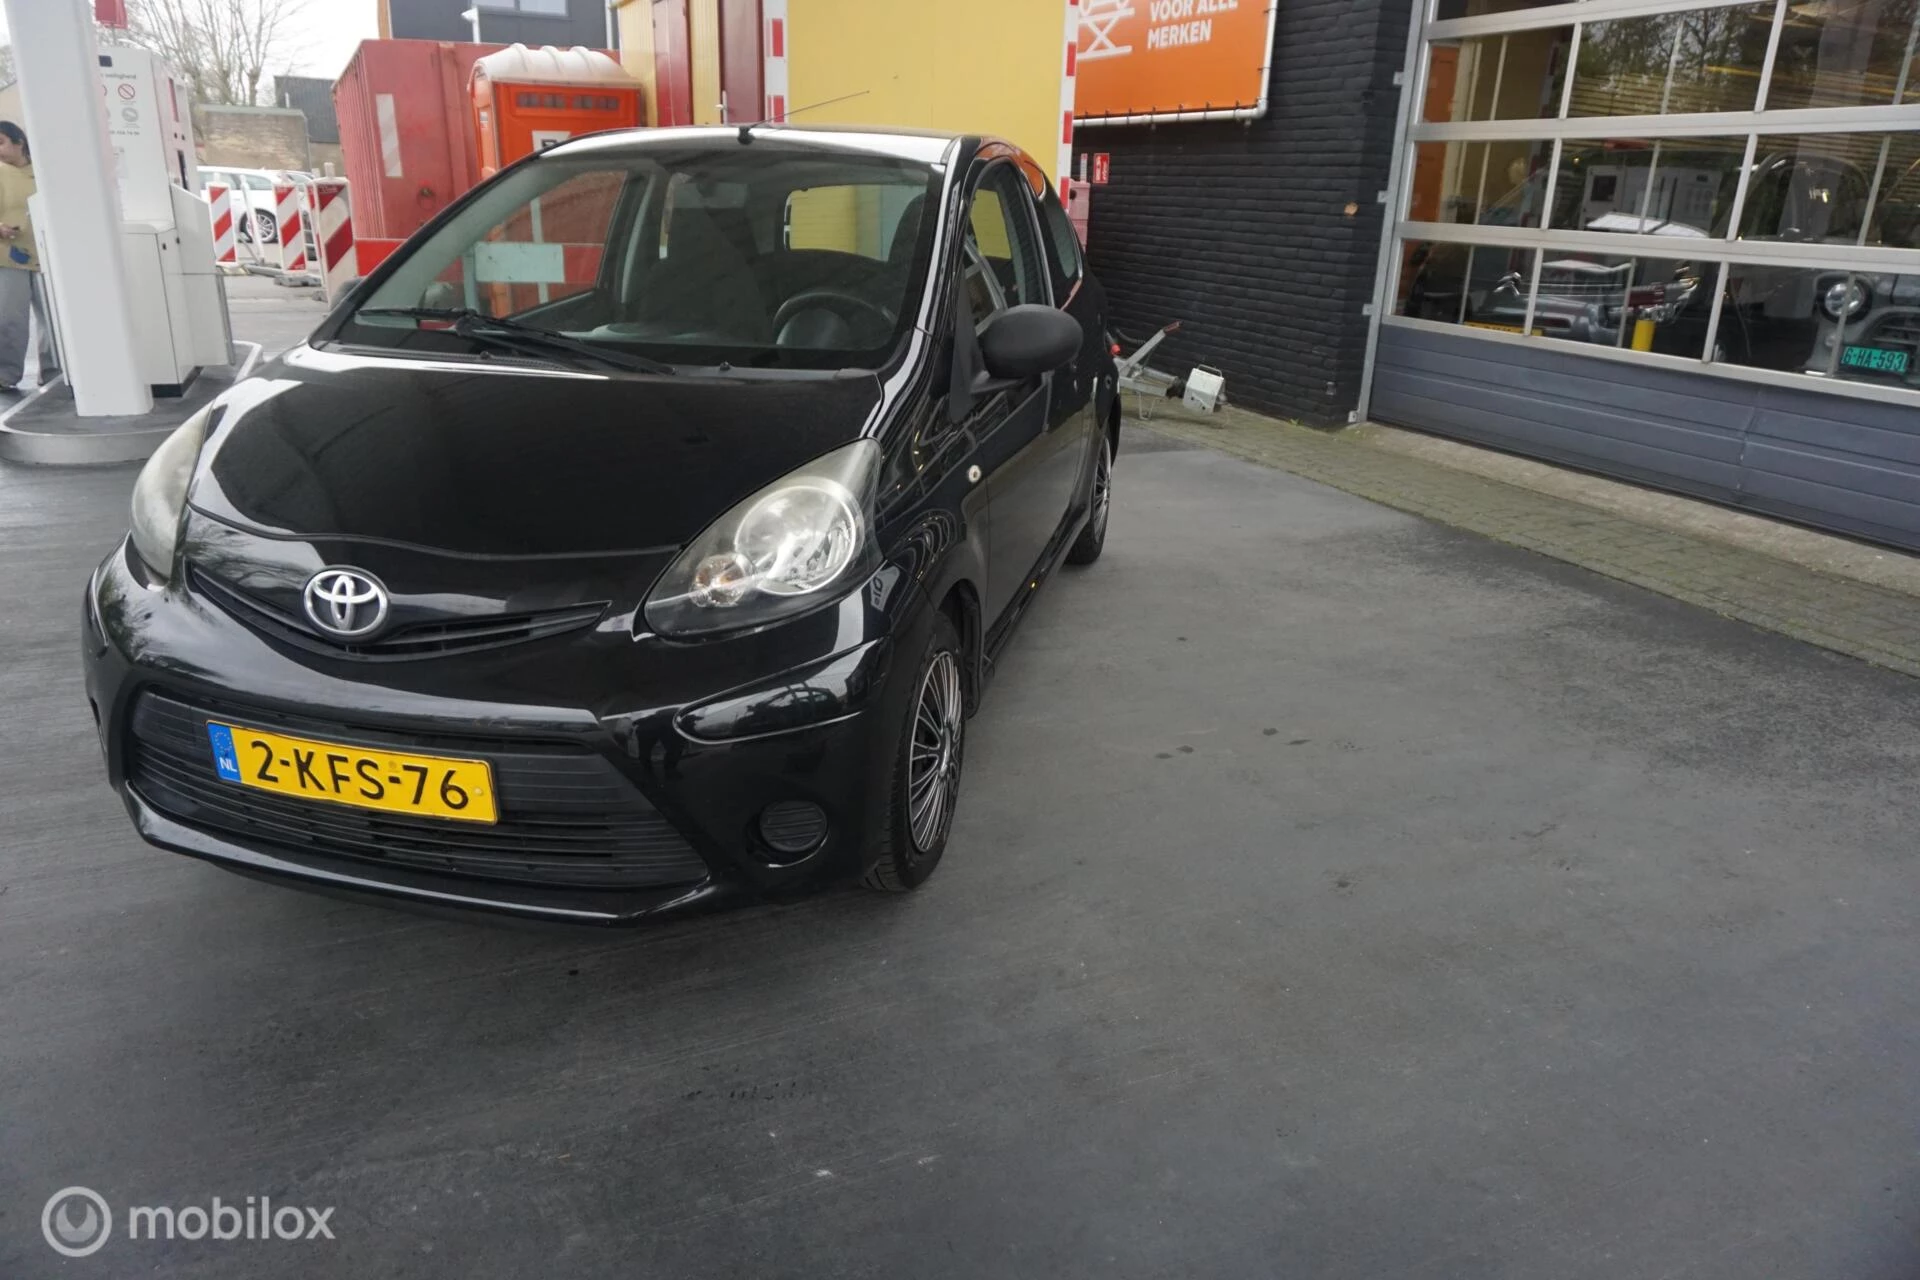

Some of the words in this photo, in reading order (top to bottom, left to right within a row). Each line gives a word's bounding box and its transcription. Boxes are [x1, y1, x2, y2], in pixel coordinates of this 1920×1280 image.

[1150, 0, 1194, 22] VOOR
[1147, 19, 1212, 49] MERKEN
[219, 757, 237, 773] NL
[251, 740, 469, 810] 2-KFS-76
